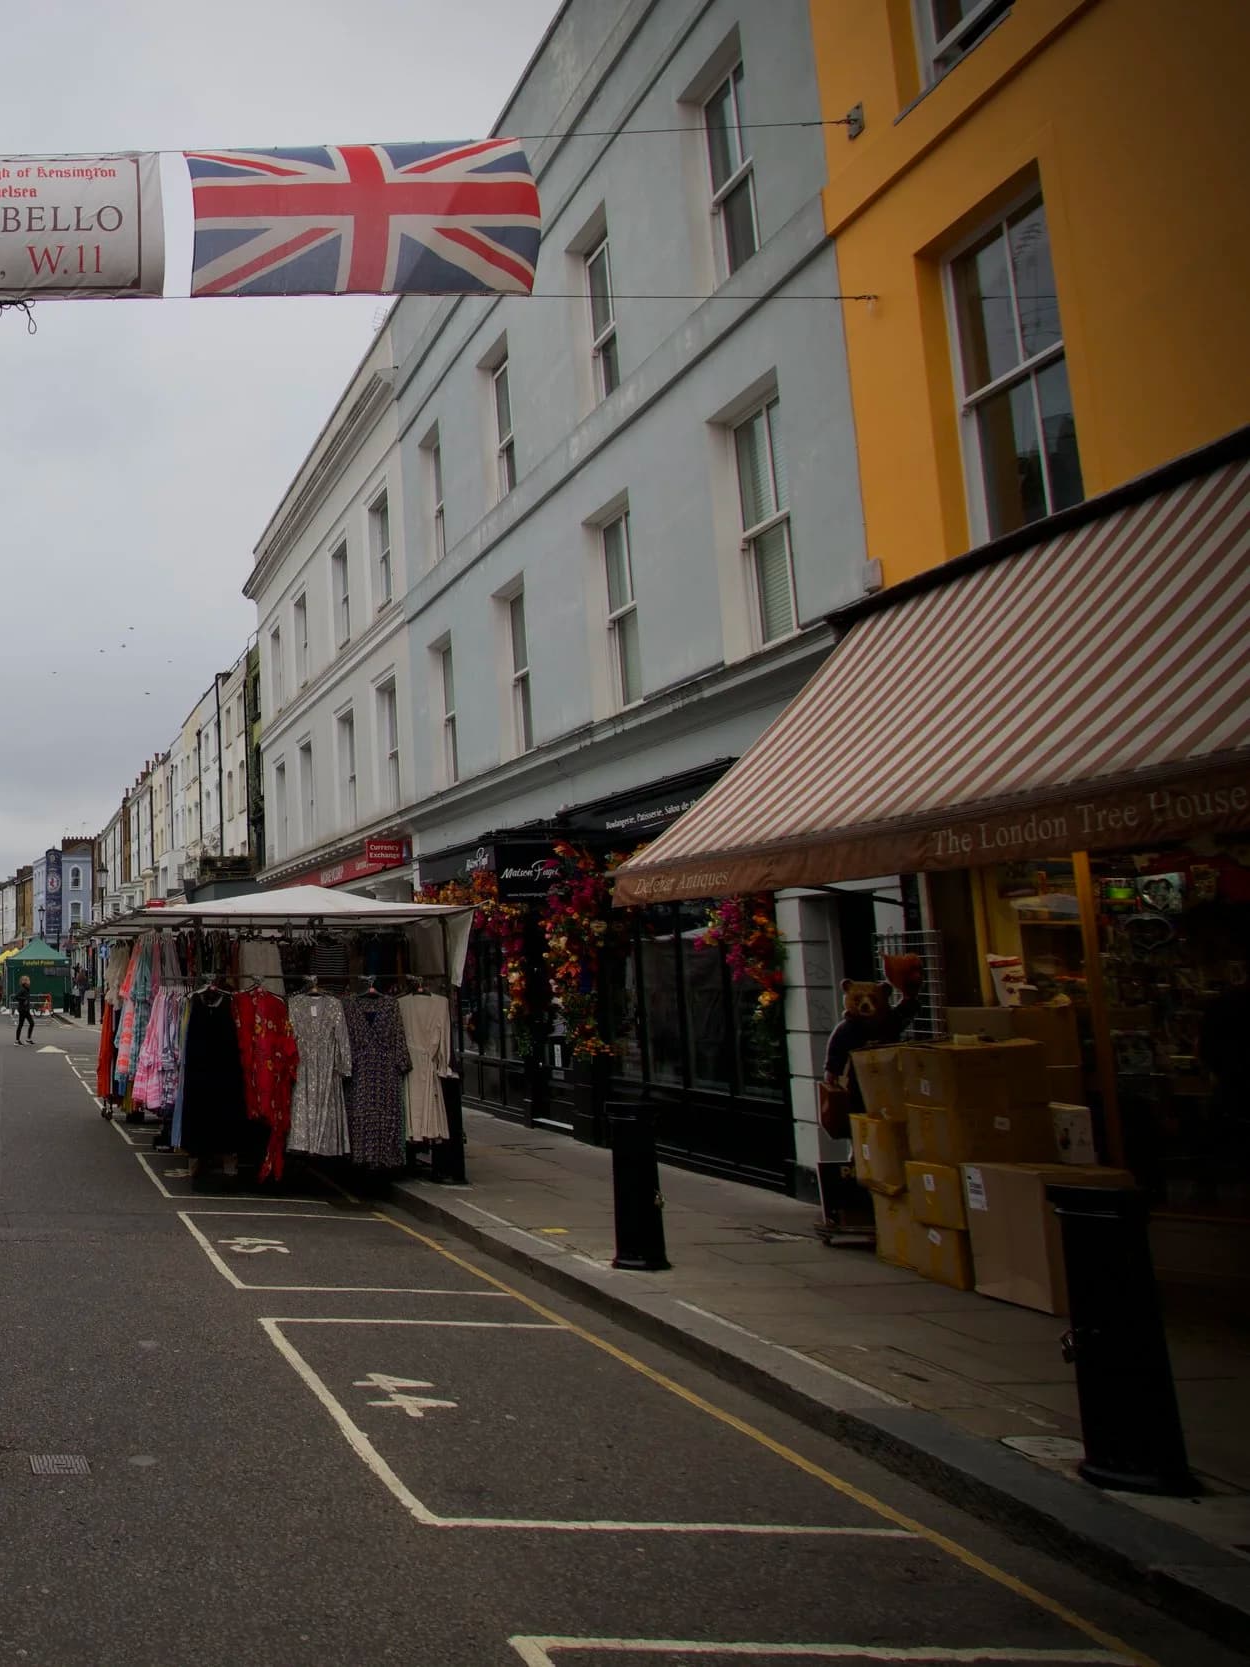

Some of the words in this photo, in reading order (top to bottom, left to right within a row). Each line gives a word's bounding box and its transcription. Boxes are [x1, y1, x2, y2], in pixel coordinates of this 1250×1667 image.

[16, 166, 31, 179] of
[36, 166, 117, 180] Kensington
[27, 245, 103, 276] W.11
[931, 829, 973, 857] The
[978, 816, 1068, 850] London
[1075, 803, 1140, 834] Tree
[1148, 785, 1248, 824] House
[369, 843, 400, 852] Currency
[369, 852, 401, 861] Exchange
[500, 867, 534, 880] Maison
[676, 869, 729, 891] Antiques
